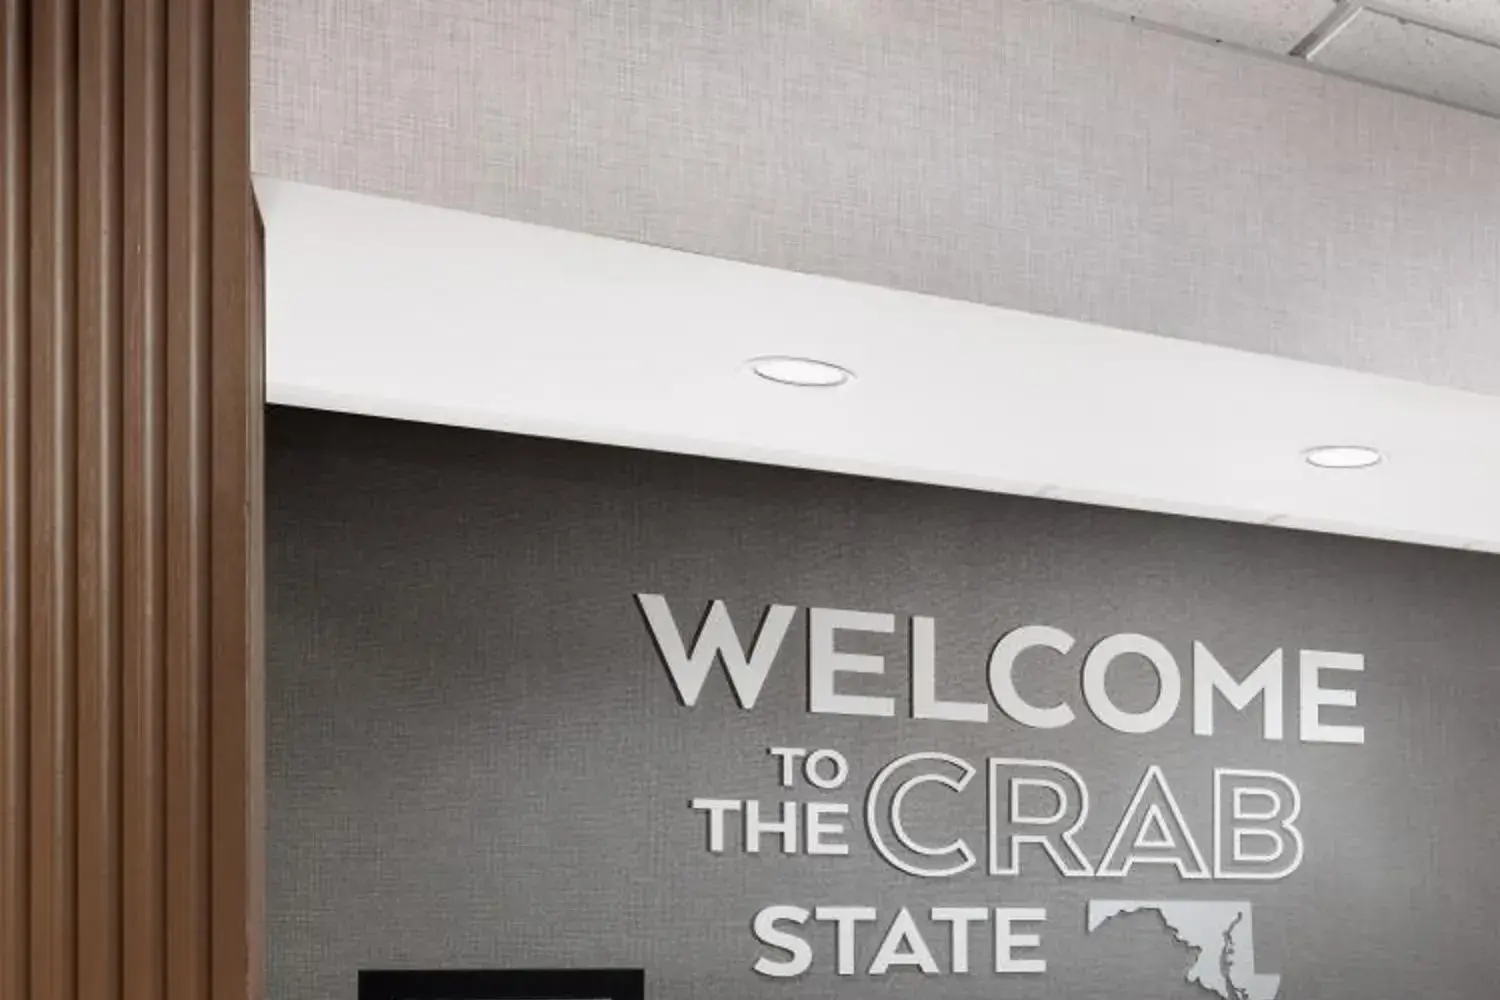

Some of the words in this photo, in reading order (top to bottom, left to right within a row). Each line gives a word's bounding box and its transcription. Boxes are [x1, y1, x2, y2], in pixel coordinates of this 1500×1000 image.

[634, 593, 1365, 744] WELCOME
[692, 799, 849, 855] THE
[866, 752, 1304, 879] CRAB
[770, 747, 849, 788] TO
[752, 906, 1047, 977] STATE
